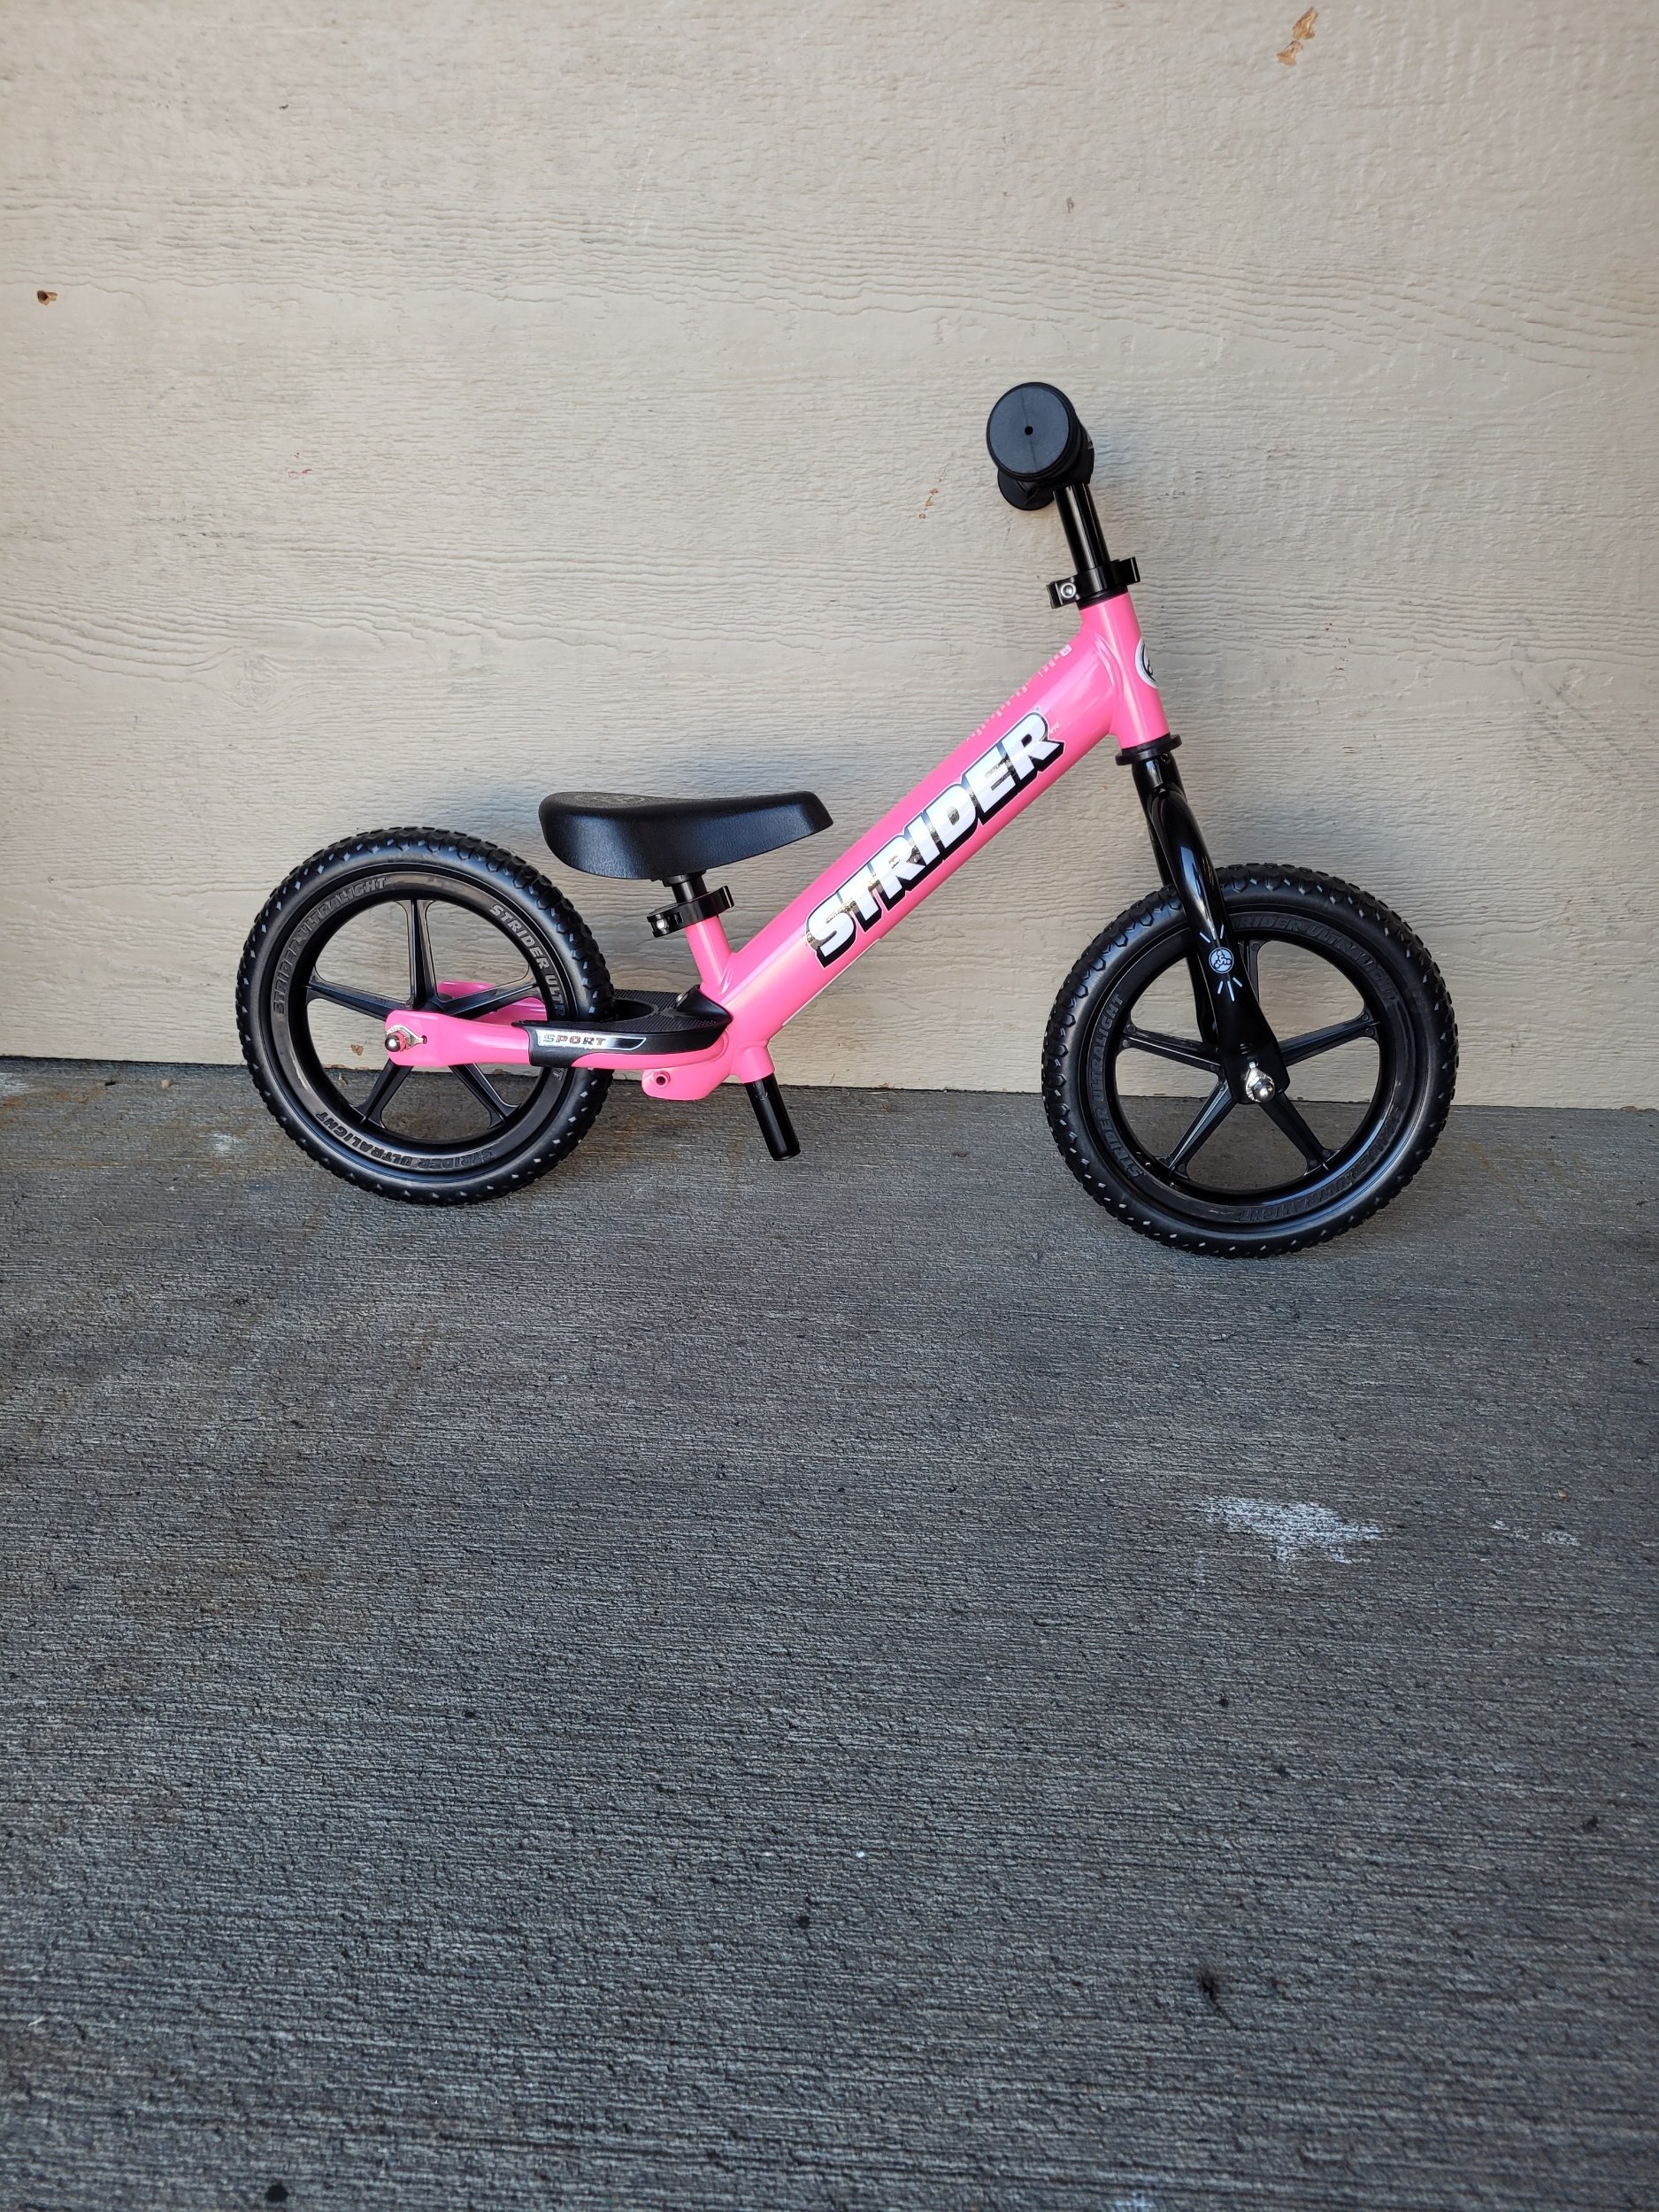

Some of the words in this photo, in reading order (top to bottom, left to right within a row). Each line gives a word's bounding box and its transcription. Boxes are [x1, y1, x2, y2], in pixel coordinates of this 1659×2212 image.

[804, 710, 1064, 969] STRIDER
[273, 938, 302, 1014] STRIDER
[296, 877, 387, 941] ULTRALIGHT
[489, 904, 549, 970] STRIDER
[542, 1033, 606, 1046] SPORT
